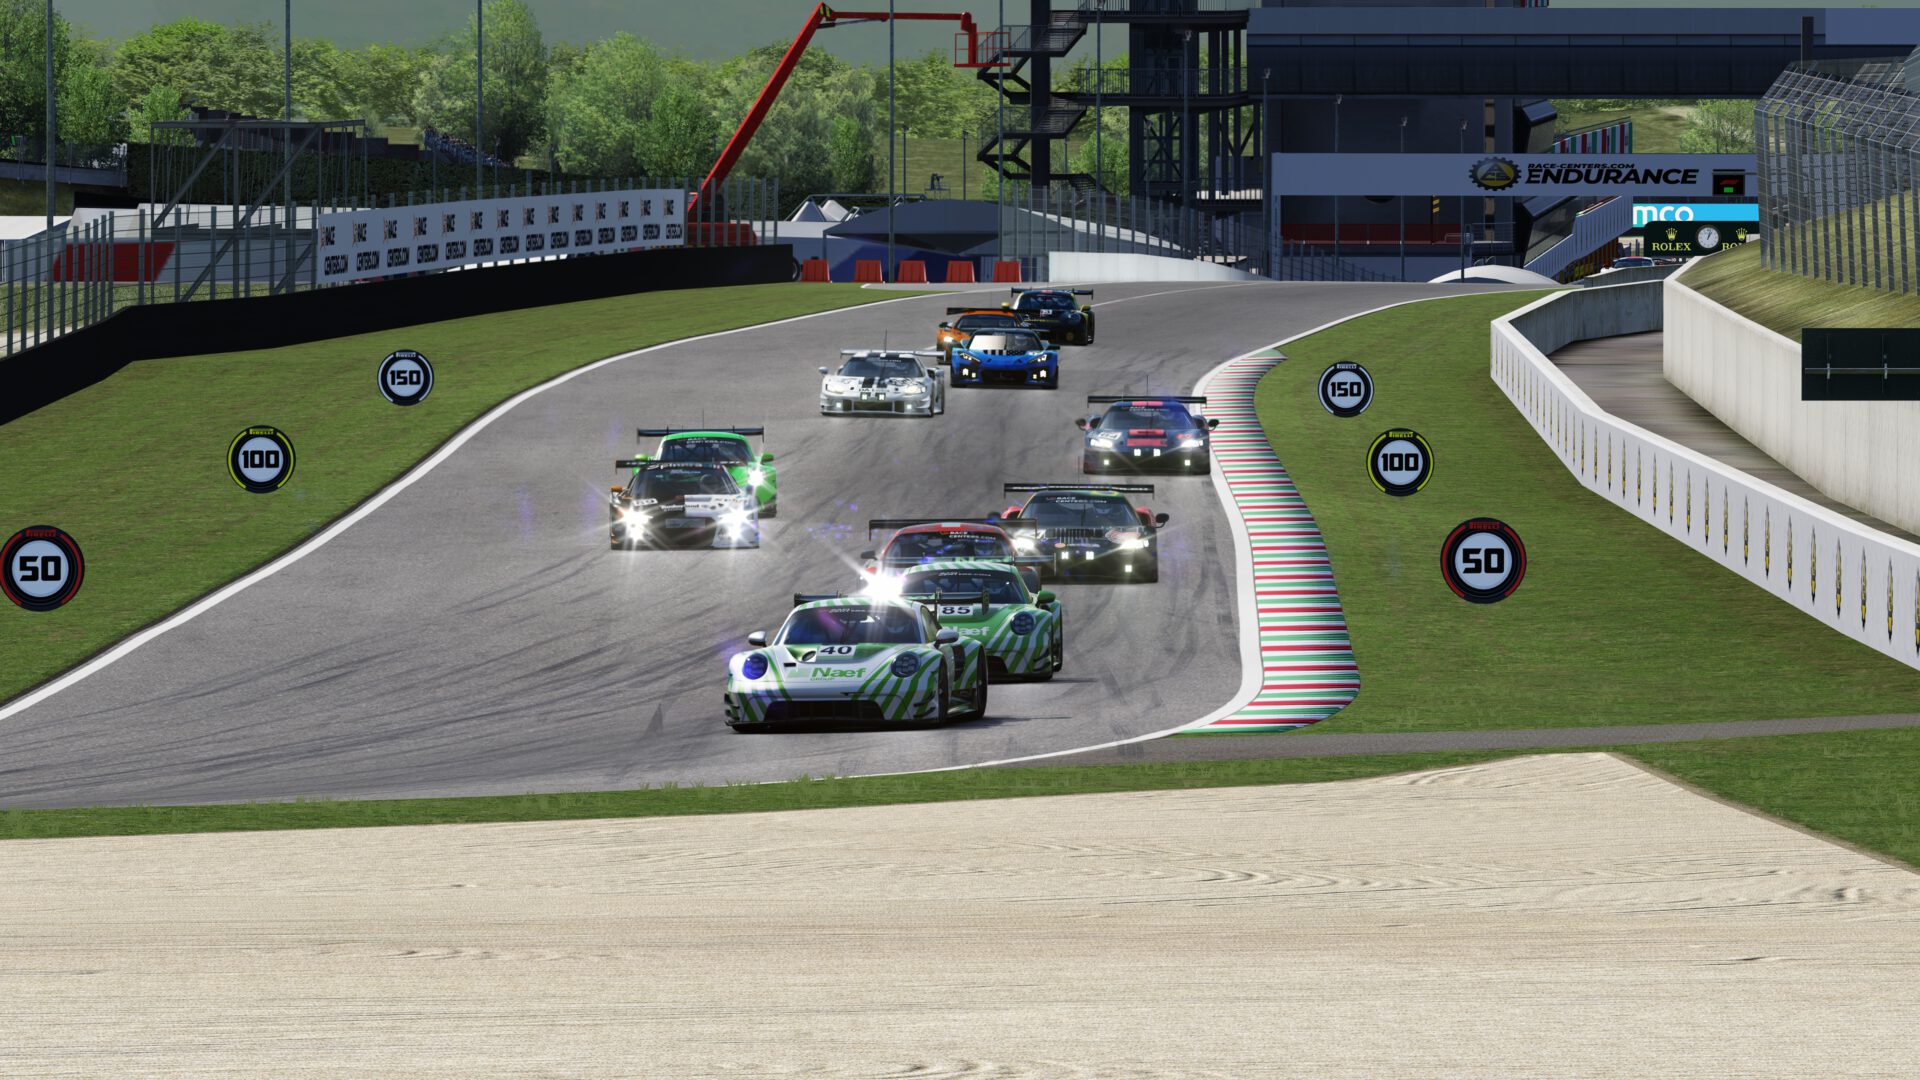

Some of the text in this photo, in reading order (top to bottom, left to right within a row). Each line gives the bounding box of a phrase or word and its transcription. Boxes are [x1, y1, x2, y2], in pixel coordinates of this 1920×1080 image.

[1525, 169, 1699, 184] ENDURANCE
[1652, 242, 1691, 251] ROLEX
[390, 370, 421, 385] 150
[1330, 382, 1361, 397] 150
[242, 450, 279, 468] 100
[1381, 453, 1419, 472] 100
[1463, 548, 1504, 574] 50
[19, 556, 61, 582] 50
[942, 606, 970, 615] 85
[820, 645, 852, 655] 40
[811, 667, 868, 678] Naef
